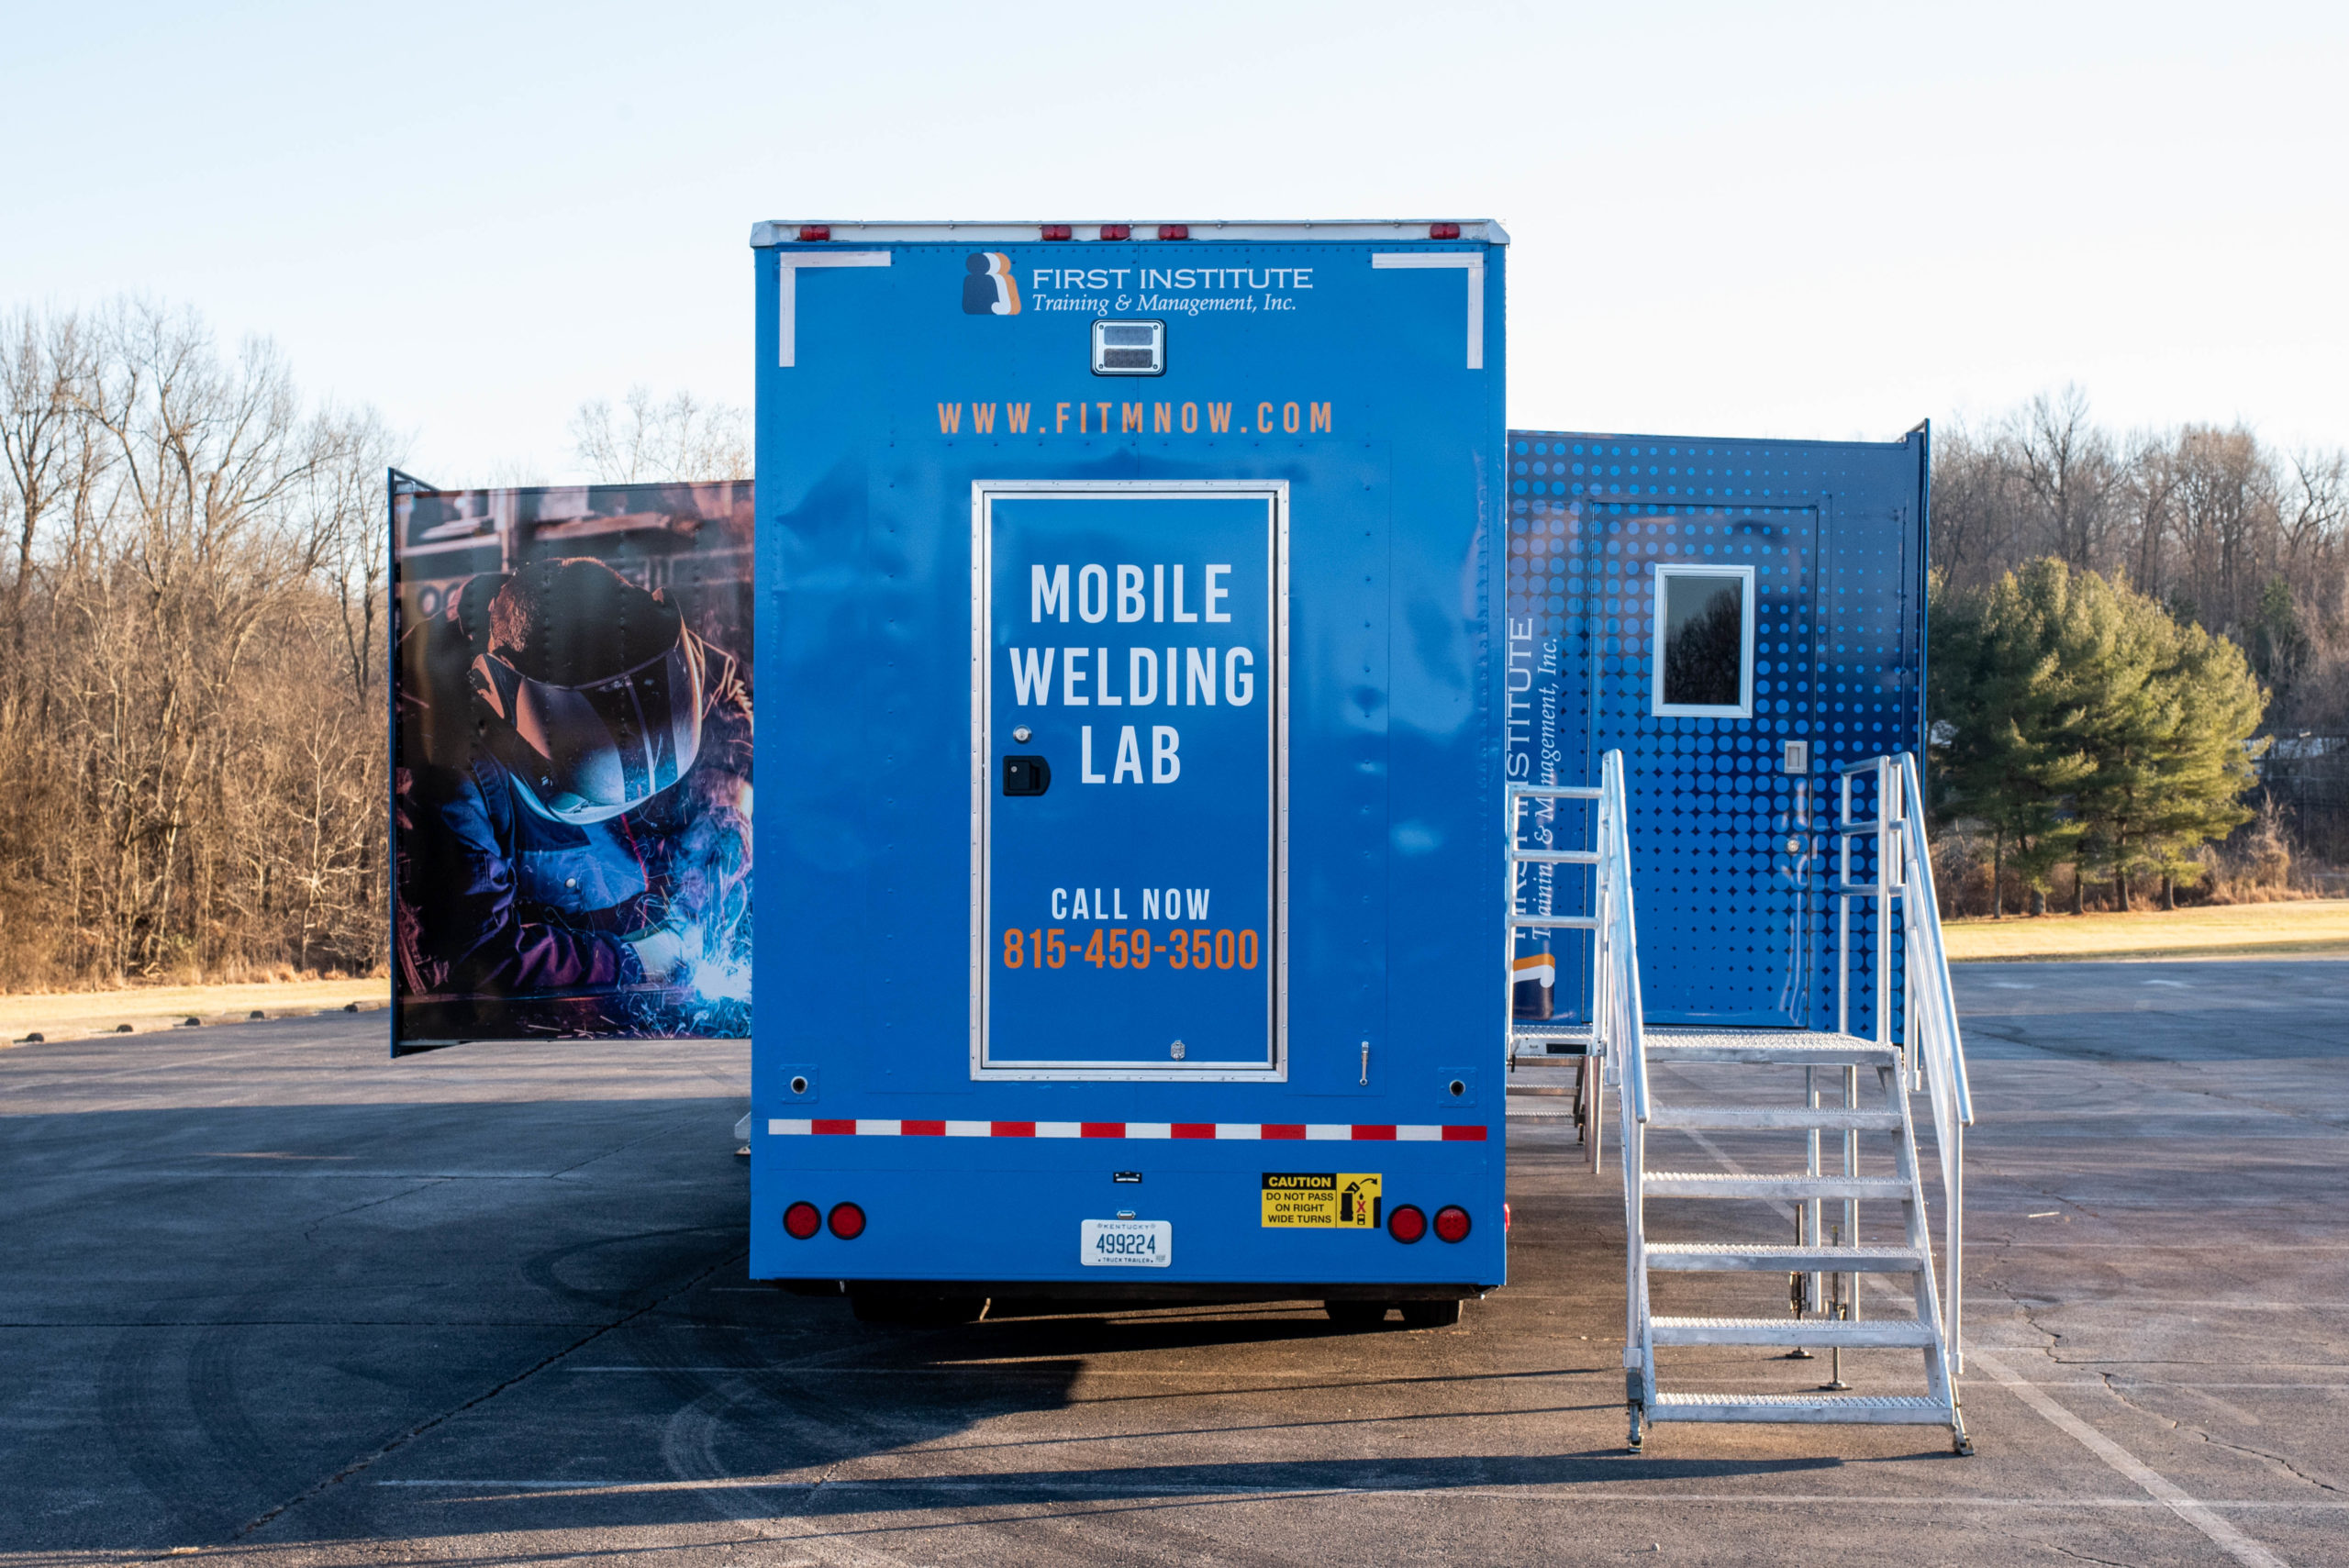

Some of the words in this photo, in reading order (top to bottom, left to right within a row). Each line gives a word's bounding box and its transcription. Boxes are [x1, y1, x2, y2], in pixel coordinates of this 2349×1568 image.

[1032, 268, 1130, 290] FIRST
[1140, 267, 1313, 289] INSTITUTE
[1032, 294, 1109, 317] Training
[1115, 294, 1132, 311] &
[1137, 294, 1257, 317] Management,
[1264, 294, 1297, 311] Inc.
[937, 401, 1334, 436] WWW.FITMNOW.COM
[1030, 563, 1232, 624] MOBILE
[1537, 638, 1558, 676] Inc.
[1008, 646, 1254, 706] WELDING
[1080, 725, 1182, 784] LAB
[1535, 682, 1562, 822] Mnagement,
[1052, 887, 1129, 920] CALL
[1142, 888, 1210, 920] NOW
[1003, 928, 1259, 970] 815-459-3500
[1266, 1192, 1281, 1201] DO
[1285, 1192, 1305, 1201] NOT
[1308, 1193, 1333, 1201] PASS
[1268, 1176, 1331, 1187] CAUTION
[1267, 1215, 1294, 1223] WIDE
[1297, 1215, 1331, 1223] TURNS
[1275, 1204, 1291, 1212] ON
[1293, 1204, 1324, 1212] RIGHT
[1096, 1233, 1155, 1254] 499224
